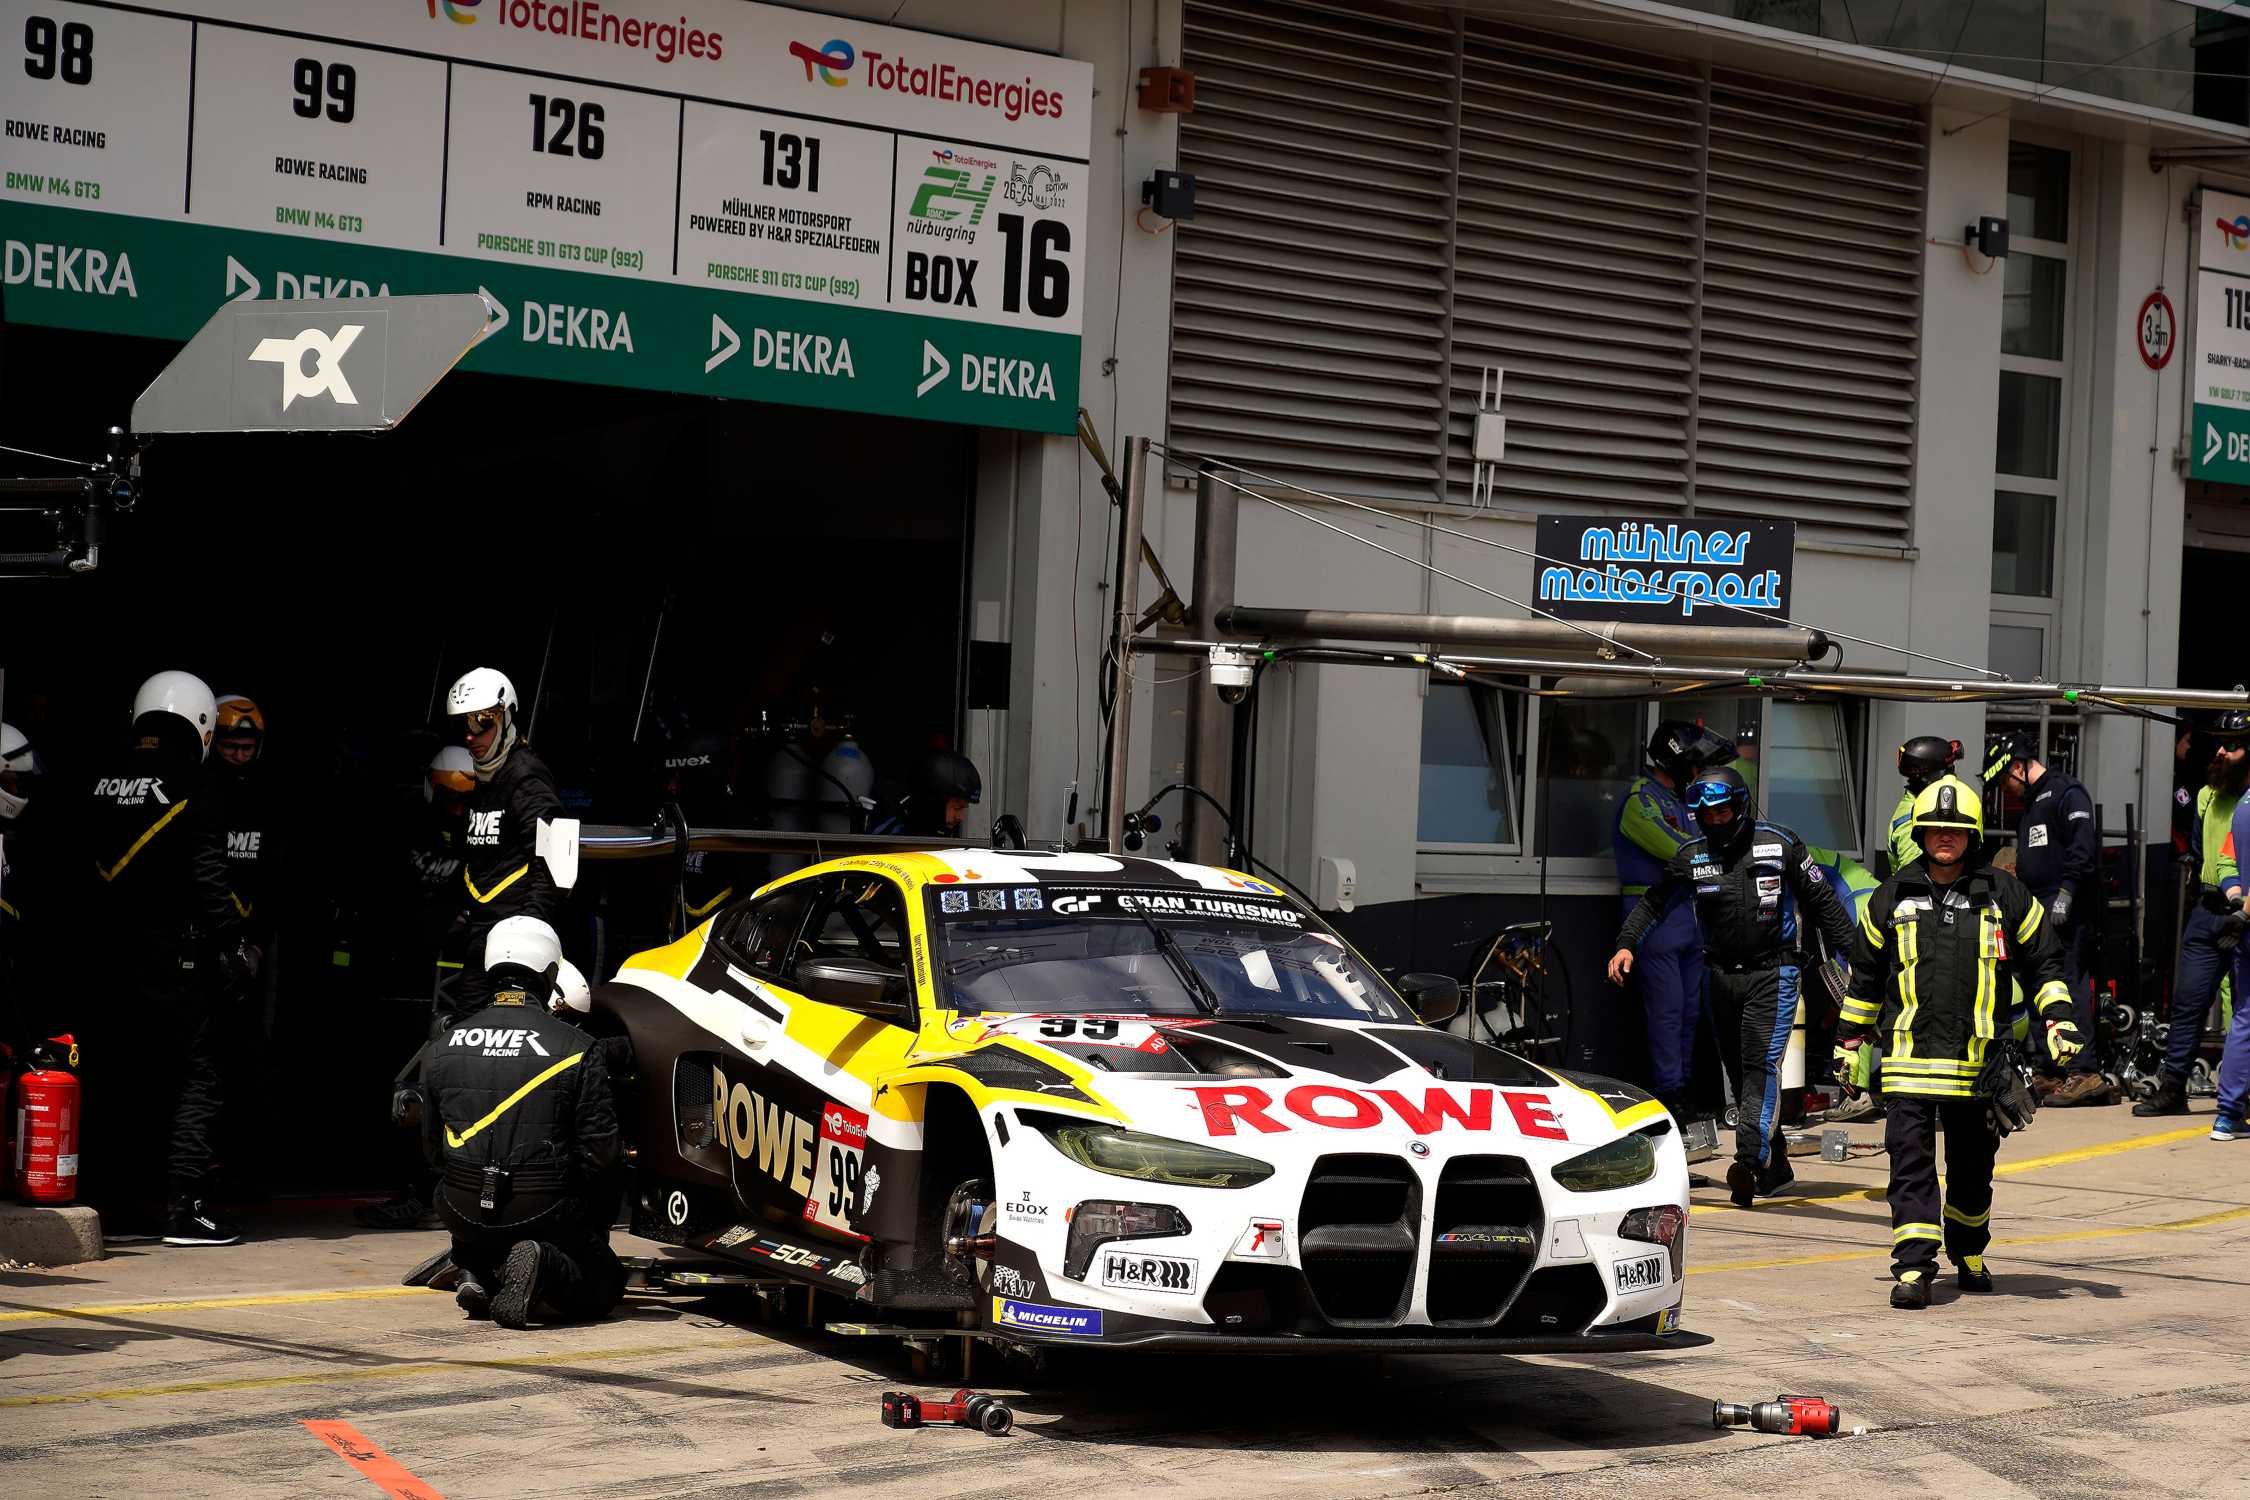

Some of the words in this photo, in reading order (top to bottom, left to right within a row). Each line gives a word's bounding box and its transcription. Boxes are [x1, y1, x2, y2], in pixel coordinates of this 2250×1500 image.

[24, 15, 94, 86] 98
[293, 57, 357, 124] 99
[862, 50, 1063, 121] TotalEnergies
[5, 119, 49, 143] ROWE
[53, 125, 106, 150] RACING
[529, 93, 605, 161] 126
[275, 157, 315, 179] ROWE
[319, 162, 368, 185] RACING
[759, 129, 821, 193] 131
[954, 154, 997, 169] TotalEnergies
[5, 171, 44, 195] BMW
[48, 176, 71, 198] M4
[74, 179, 101, 200] GT3
[1003, 181, 1033, 203] 26-29
[1045, 182, 1069, 193] EDITION
[527, 191, 553, 210] RPM
[557, 195, 601, 216] RACING
[722, 197, 775, 222] MÜHLNER
[778, 207, 852, 232] MOTORSPORT
[275, 206, 311, 227] BMW
[314, 211, 335, 230] M4
[338, 213, 363, 234] GT3
[690, 214, 746, 236] POWERED
[749, 222, 764, 239] BY
[767, 225, 792, 243] H&R
[794, 229, 880, 255] SPEZIALFEDERN
[906, 219, 976, 244] nürburgring
[478, 232, 534, 255] PORSCHE
[537, 240, 556, 257] 911
[559, 243, 581, 260] GT3
[584, 246, 608, 264] CUP
[611, 247, 644, 272] (992)
[998, 213, 1070, 319] 16
[4, 240, 138, 299] DEKRA
[707, 262, 758, 284] PORSCHE
[762, 270, 779, 286] 911
[781, 272, 802, 289] GT3
[805, 275, 827, 292] CUP
[829, 276, 860, 299] (992)
[906, 251, 979, 308] BOX
[523, 301, 634, 354] DEKRA
[753, 328, 855, 378] DEKRA
[962, 354, 1055, 401] DEKRA
[1580, 522, 1751, 565] mühlner
[1540, 564, 1781, 617] motorsport
[665, 754, 711, 769] uvex
[1983, 753, 2012, 782] 100%
[94, 777, 151, 797] ROWE
[1117, 895, 1186, 909] GRAN
[1185, 908, 1232, 919] DRIVING
[1235, 913, 1302, 929] SIMULATOR
[448, 1028, 528, 1048] ROWE
[482, 1047, 520, 1056] RACING
[1176, 1085, 1570, 1142] ROWE
[713, 1064, 814, 1198] ROWE
[829, 1145, 859, 1221] 99
[1006, 1202, 1048, 1215] EDOX
[769, 1244, 811, 1265] 50
[1105, 1256, 1163, 1283] H&R
[1000, 1276, 1036, 1299] KW
[1615, 1260, 1647, 1290] H&R
[1018, 1311, 1088, 1327] MICHELIN
